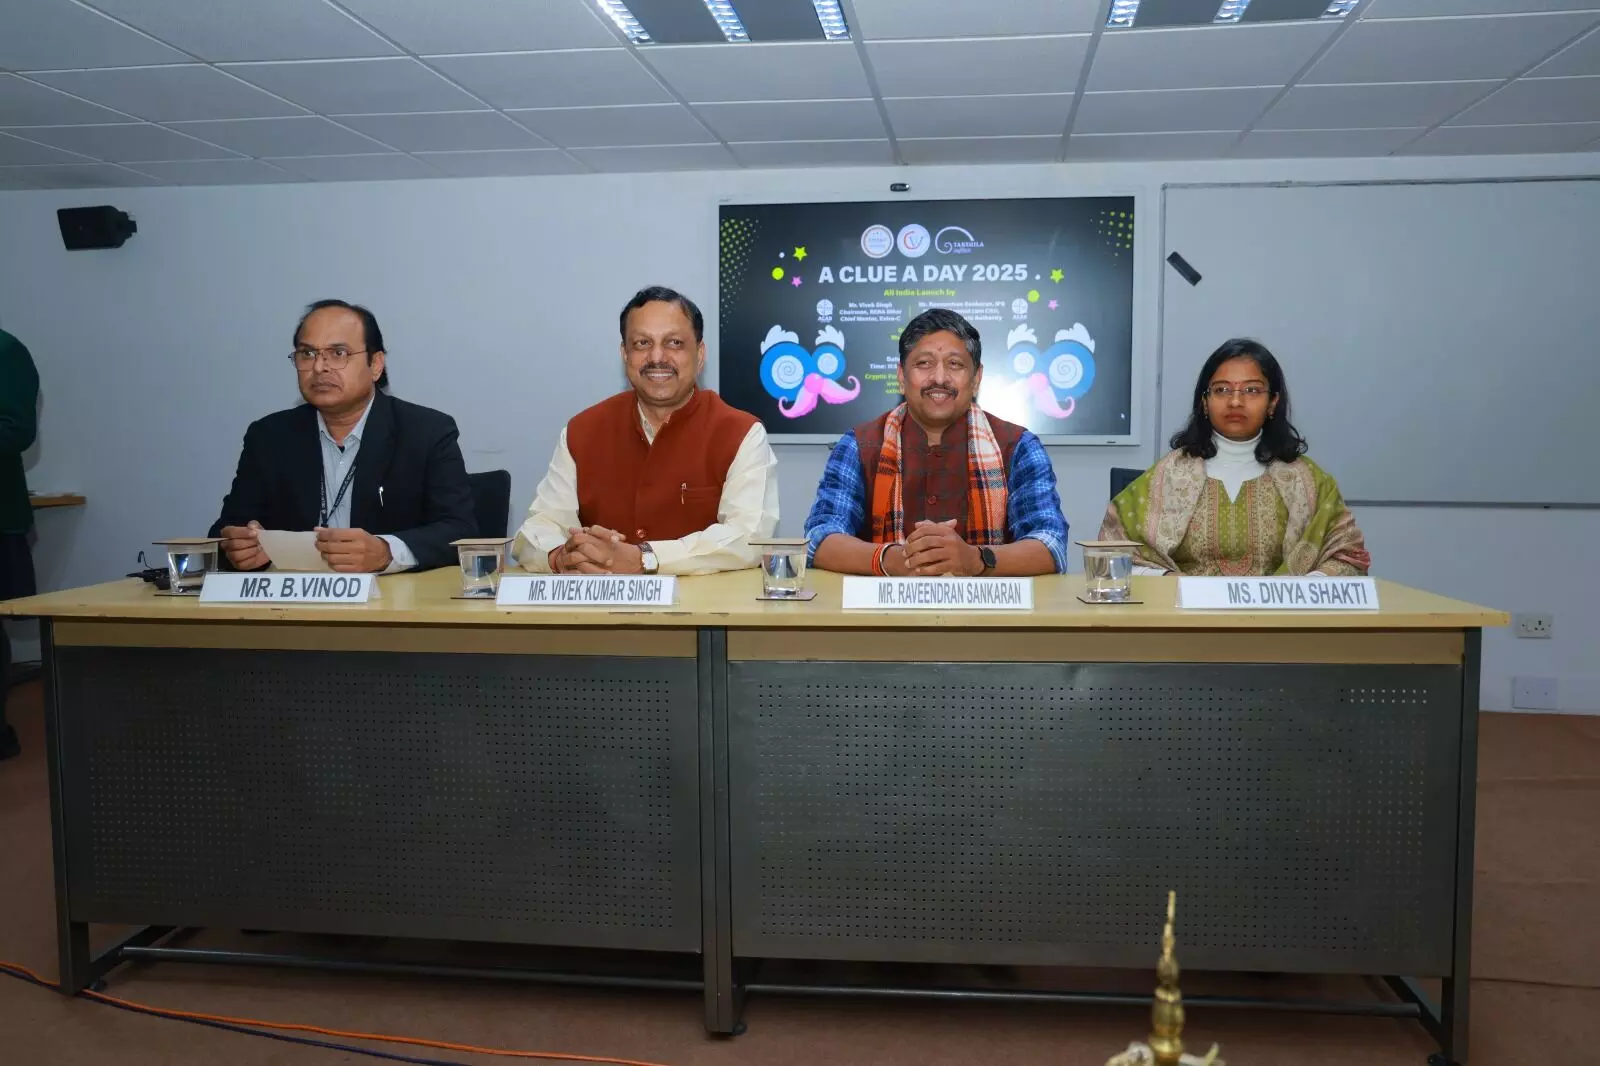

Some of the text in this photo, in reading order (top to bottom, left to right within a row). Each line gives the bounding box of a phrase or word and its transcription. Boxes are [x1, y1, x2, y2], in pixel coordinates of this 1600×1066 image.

[818, 264, 1028, 284] A CLUE A DAY 2025
[883, 288, 956, 298] All India Launch by
[240, 577, 361, 598] MR. B.VINOD
[528, 580, 662, 601] MR. VIVEK KUMAR SINGH
[878, 582, 1021, 604] MR. RAVEENDRAN SANKARAN
[1227, 582, 1368, 604] MS. DIVYA SHAKTI
